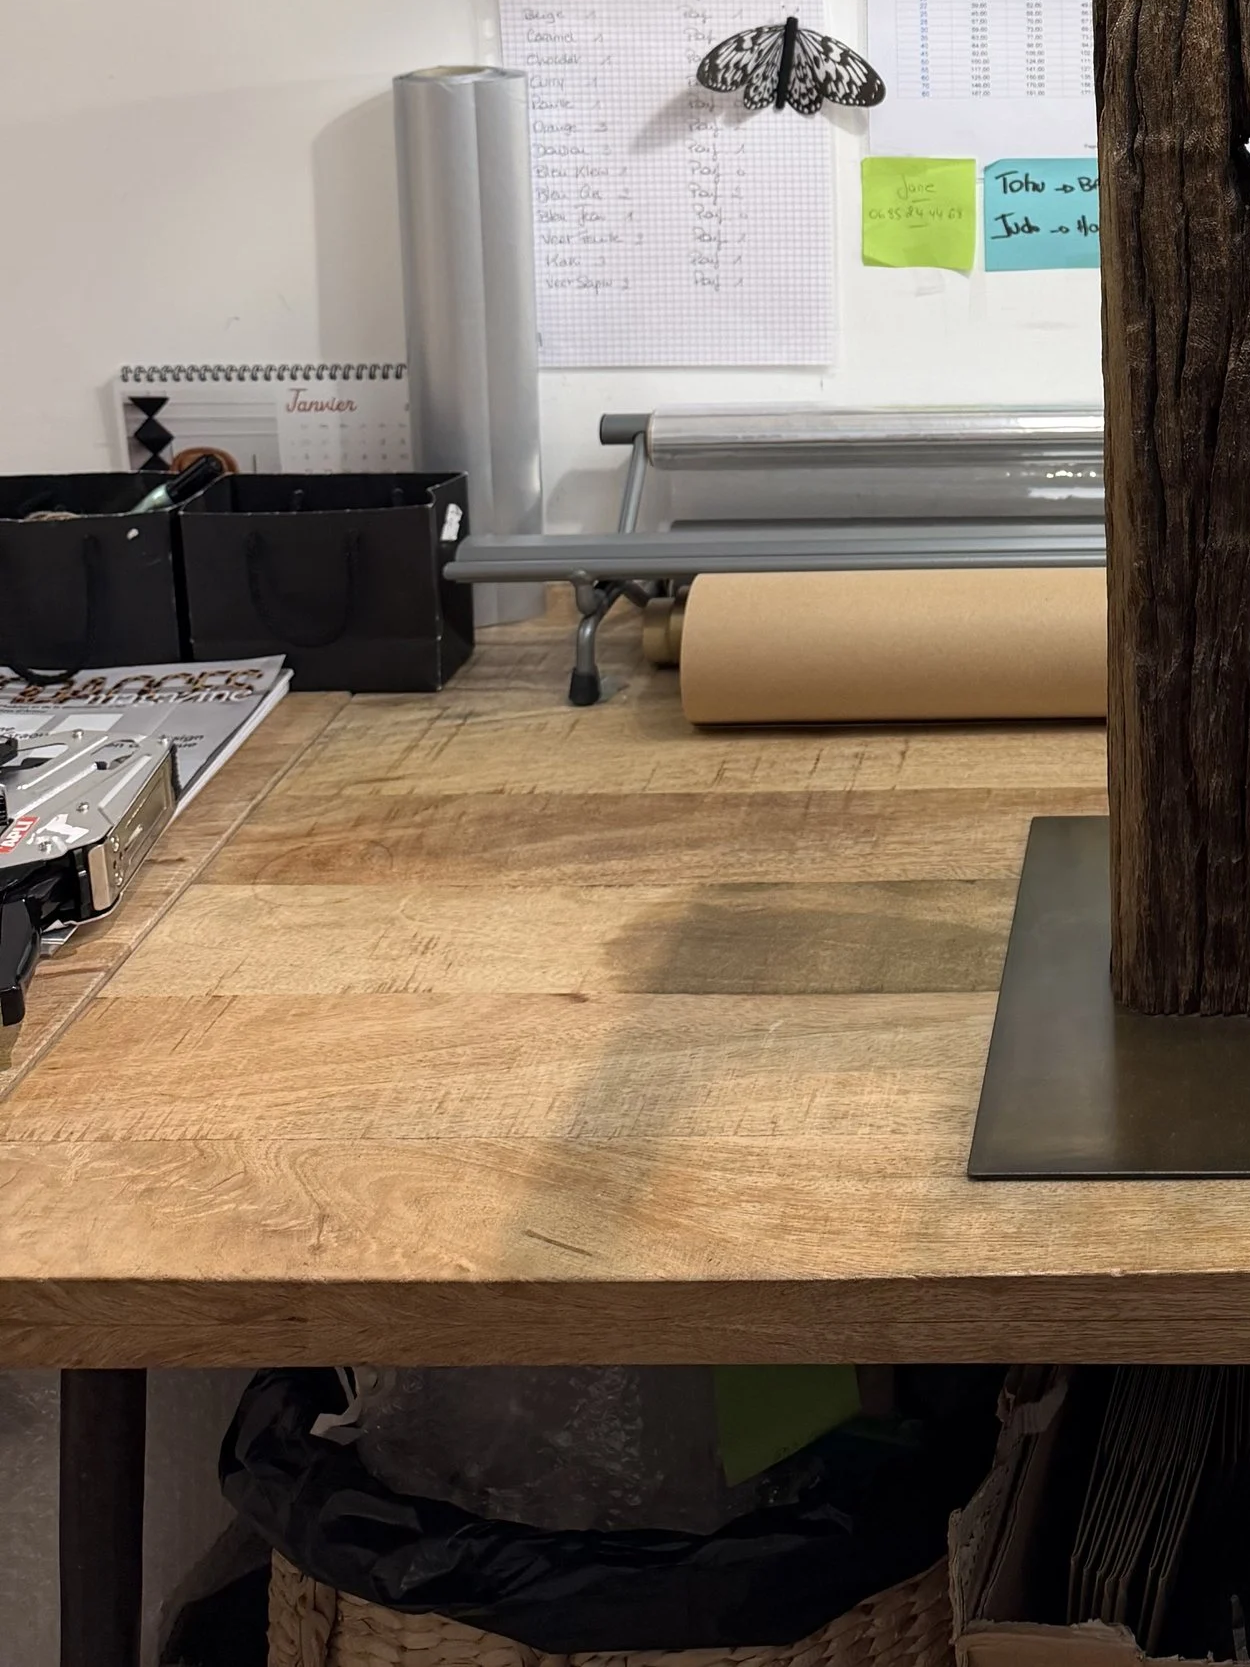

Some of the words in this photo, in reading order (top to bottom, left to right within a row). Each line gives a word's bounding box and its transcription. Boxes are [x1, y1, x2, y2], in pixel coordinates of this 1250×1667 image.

[523, 8, 566, 24] Beige
[527, 28, 577, 43] Caramel
[286, 388, 357, 414] Janvier
[87, 686, 253, 706] magazine
[1, 820, 34, 848] APLI
